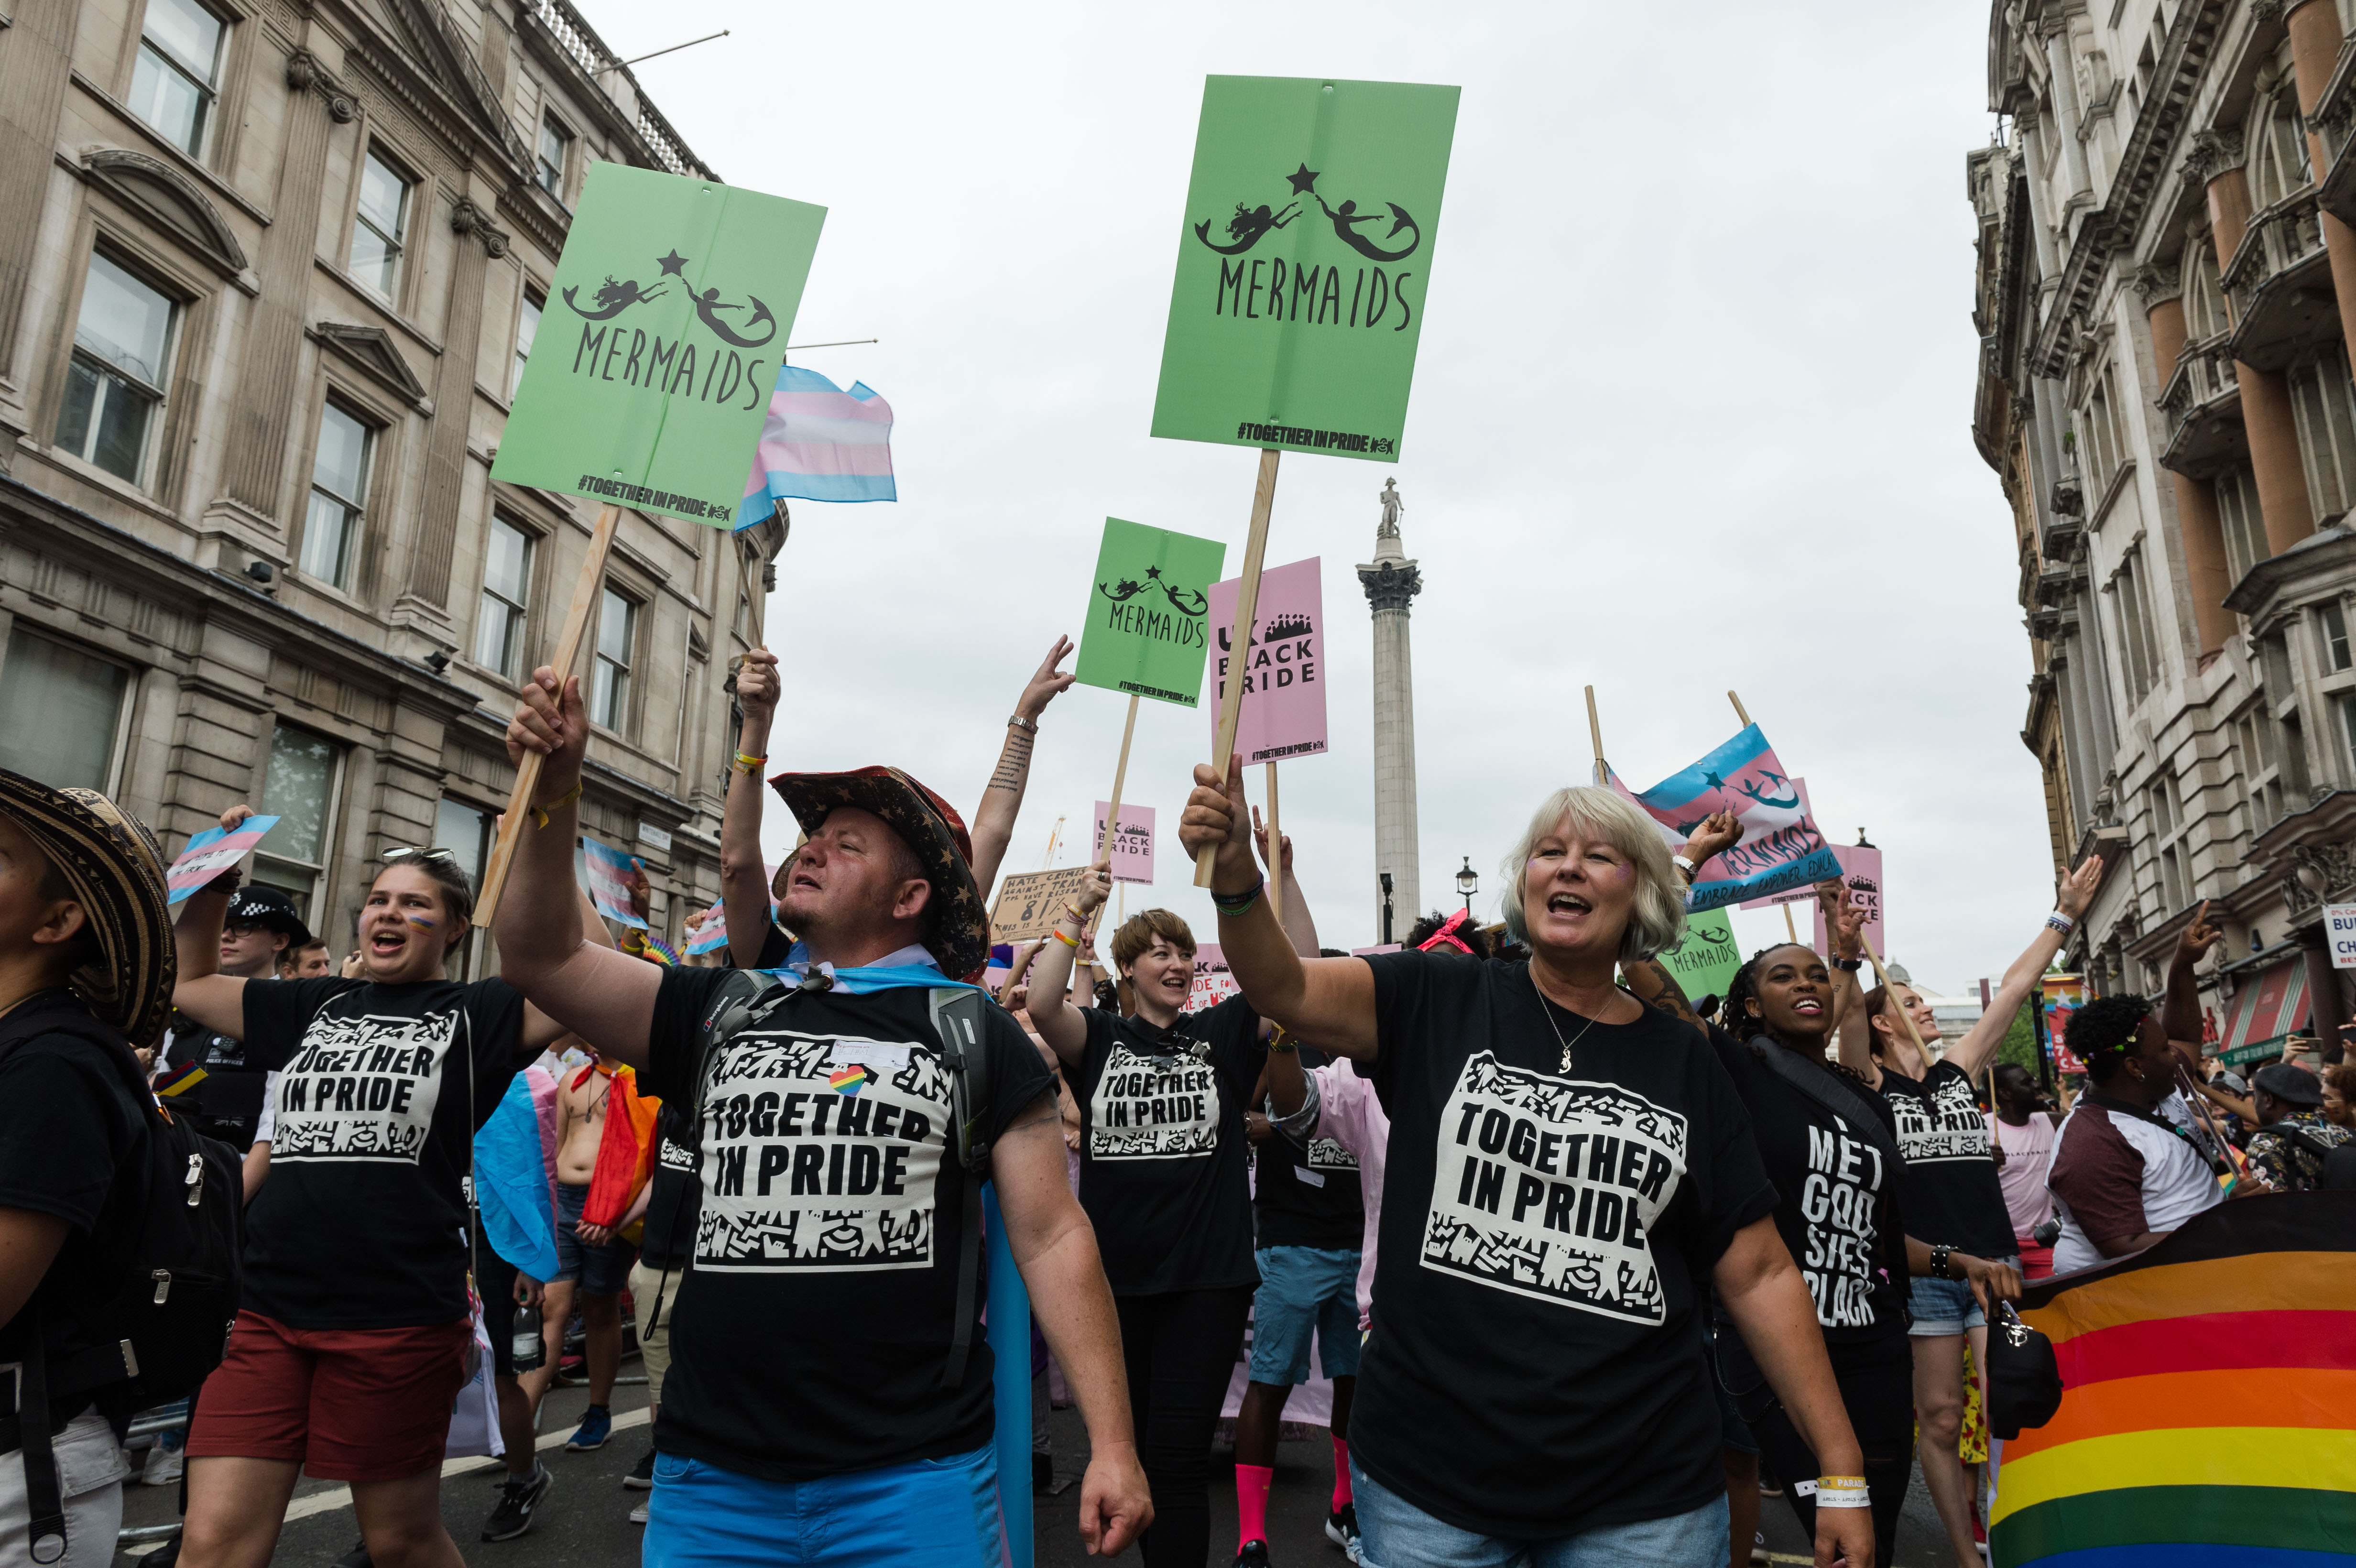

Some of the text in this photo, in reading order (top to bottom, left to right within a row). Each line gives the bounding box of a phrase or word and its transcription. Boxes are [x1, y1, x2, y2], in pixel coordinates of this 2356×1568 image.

[1216, 257, 1411, 331] MERMAIDS
[573, 321, 764, 411] MERMAIDS
[1109, 601, 1204, 648] MERMAIDS
[1219, 639, 1314, 676] BACK
[1098, 832, 1149, 846] BACK
[1004, 879, 1081, 895] AGAINST TRAN
[1007, 869, 1086, 888] HATE CRIMES
[1023, 892, 1043, 900] HAVE
[1047, 888, 1079, 899] RISEN
[1693, 883, 1750, 906] EMBRACE
[1672, 944, 1737, 973] MERMAIDS
[1190, 978, 1213, 992] IDE
[286, 1044, 435, 1078] TOGETHER
[283, 1076, 415, 1114] IN PRIDE
[1103, 1070, 1210, 1098] TOGETHER
[714, 1091, 931, 1143] TOGETHER
[1106, 1094, 1206, 1127] IN PRIDE
[1902, 1116, 1924, 1134] IN
[1455, 1101, 1673, 1204] TOGETHER
[1808, 1125, 1882, 1191] MET
[714, 1143, 911, 1197] IN PRIDE
[1457, 1154, 1646, 1251] IN PRIDE
[1801, 1173, 1877, 1240] GOD
[1837, 1479, 1864, 1488] PARADE
